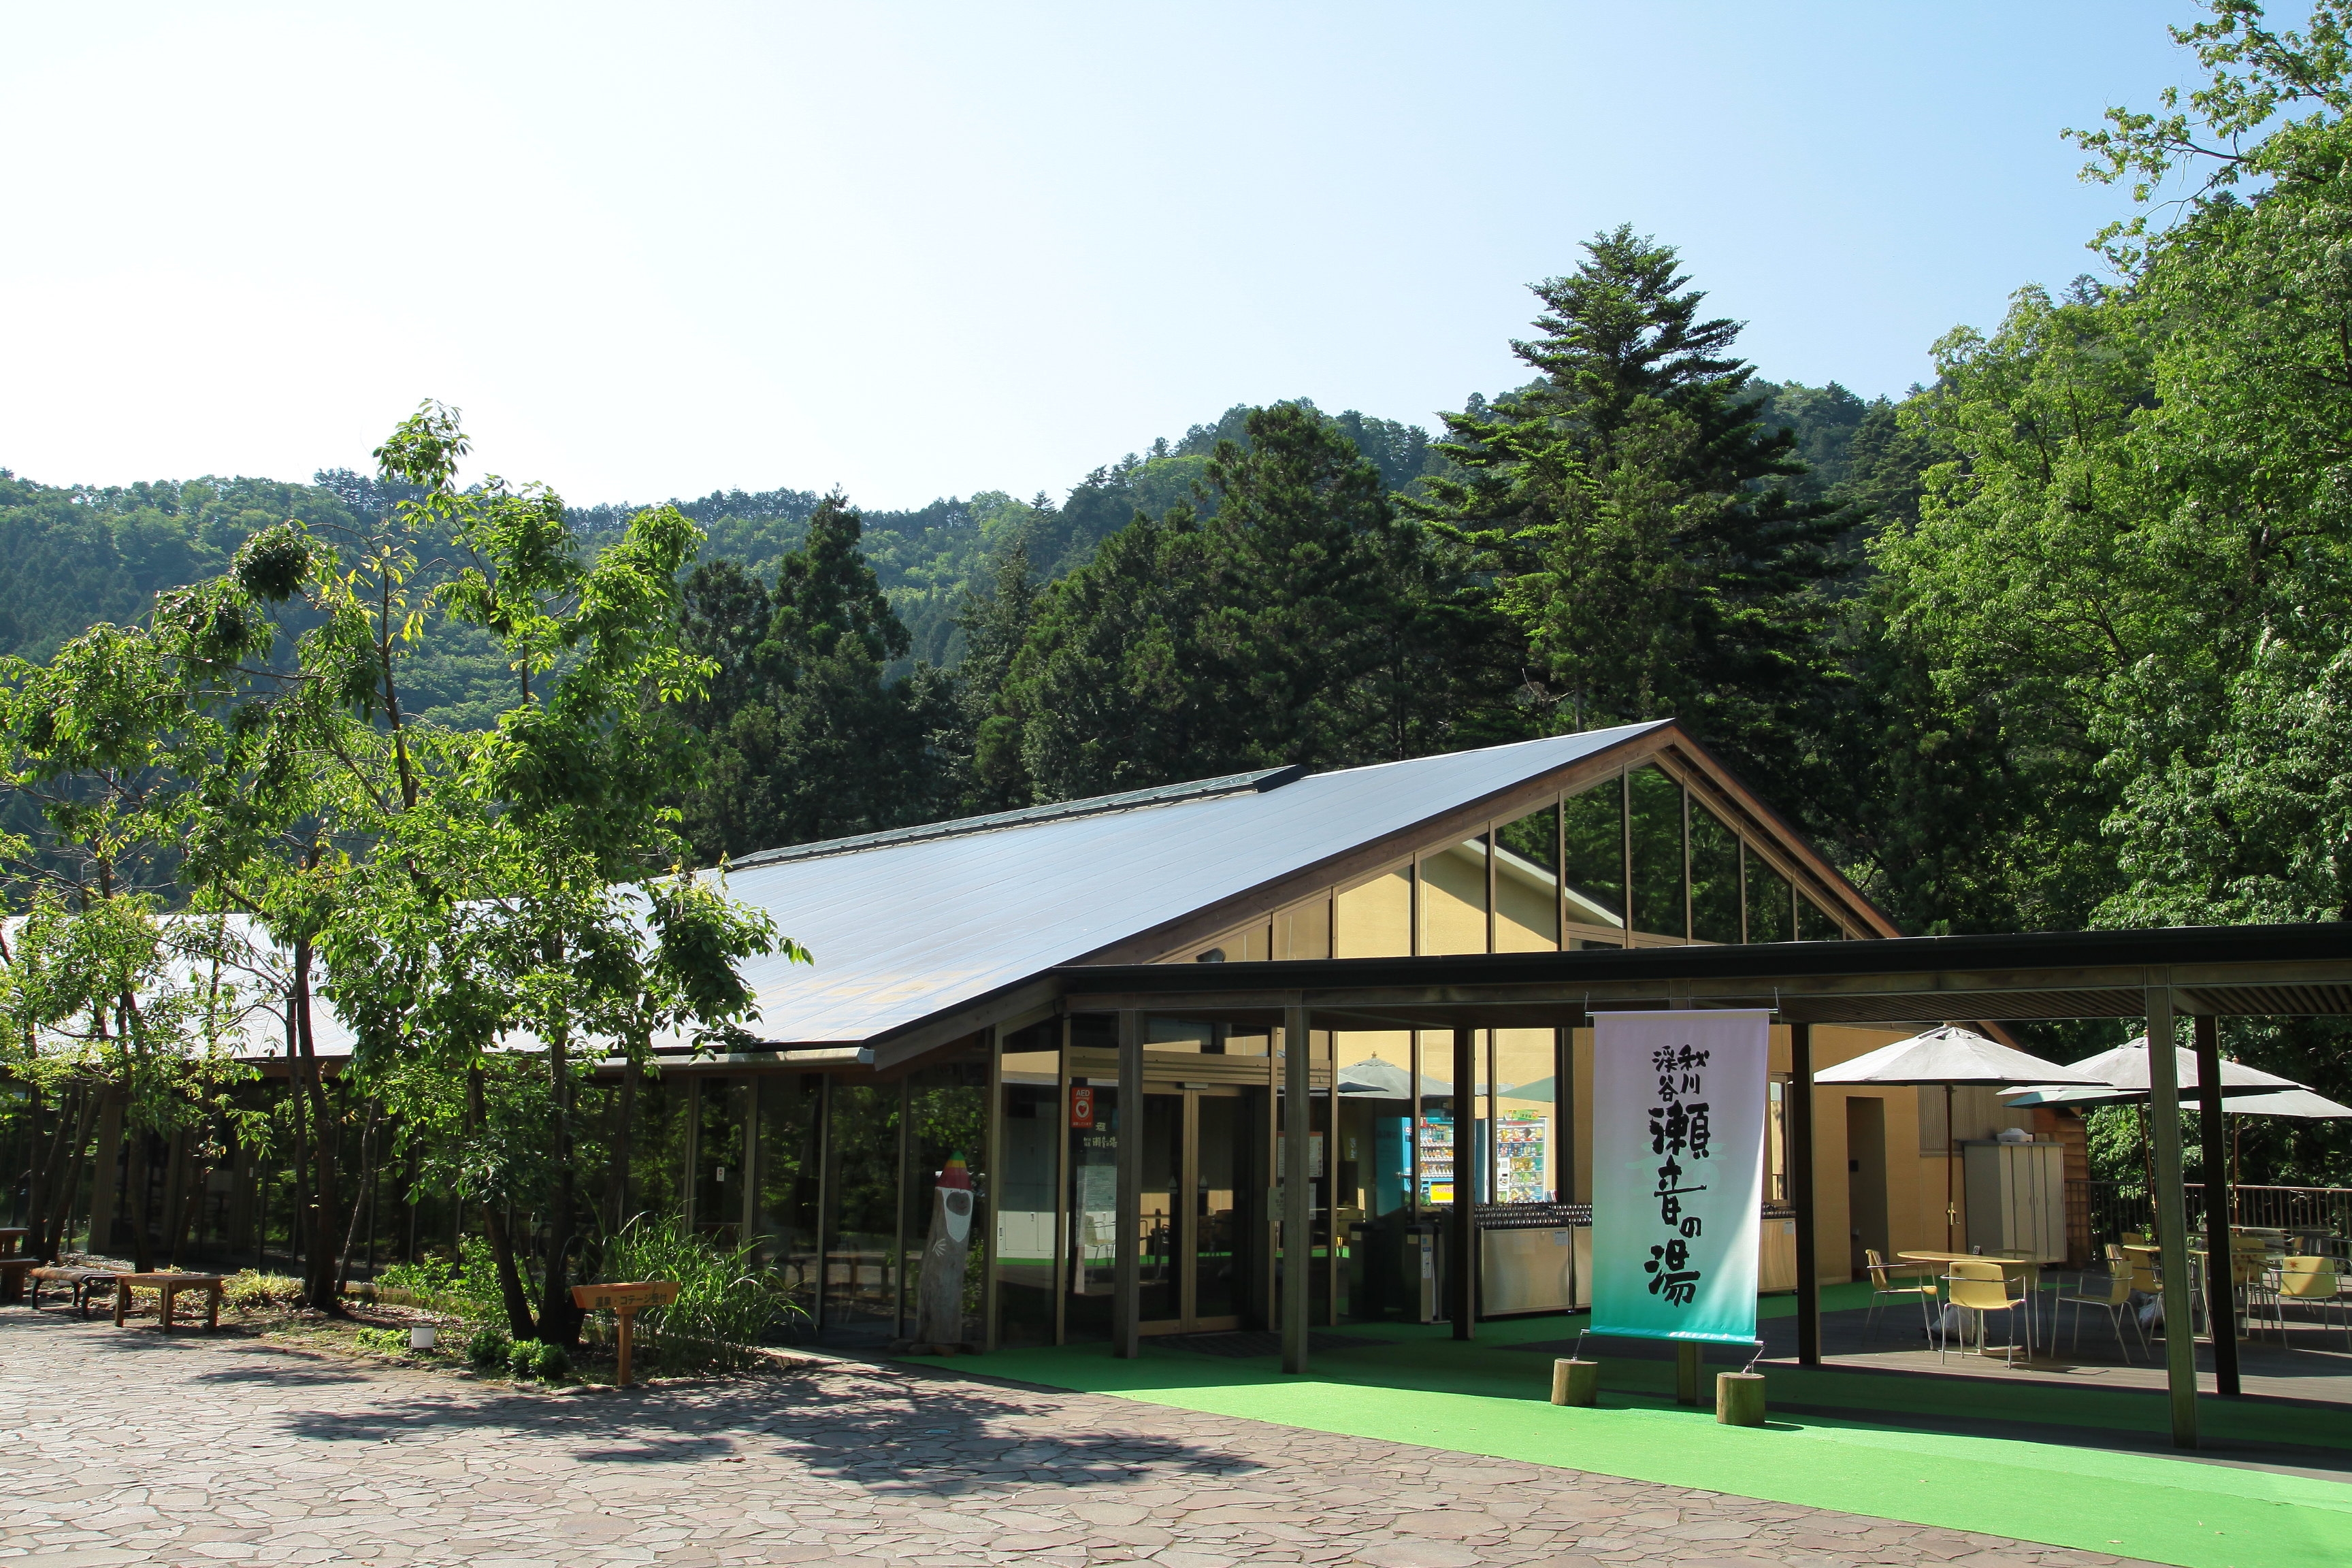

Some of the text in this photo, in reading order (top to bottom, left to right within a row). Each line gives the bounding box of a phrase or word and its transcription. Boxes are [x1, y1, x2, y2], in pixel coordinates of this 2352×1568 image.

[1651, 1045, 1678, 1102] 渓谷
[1677, 1044, 1710, 1095] 秋川
[1644, 1100, 1711, 1308] 瀬音の湯
